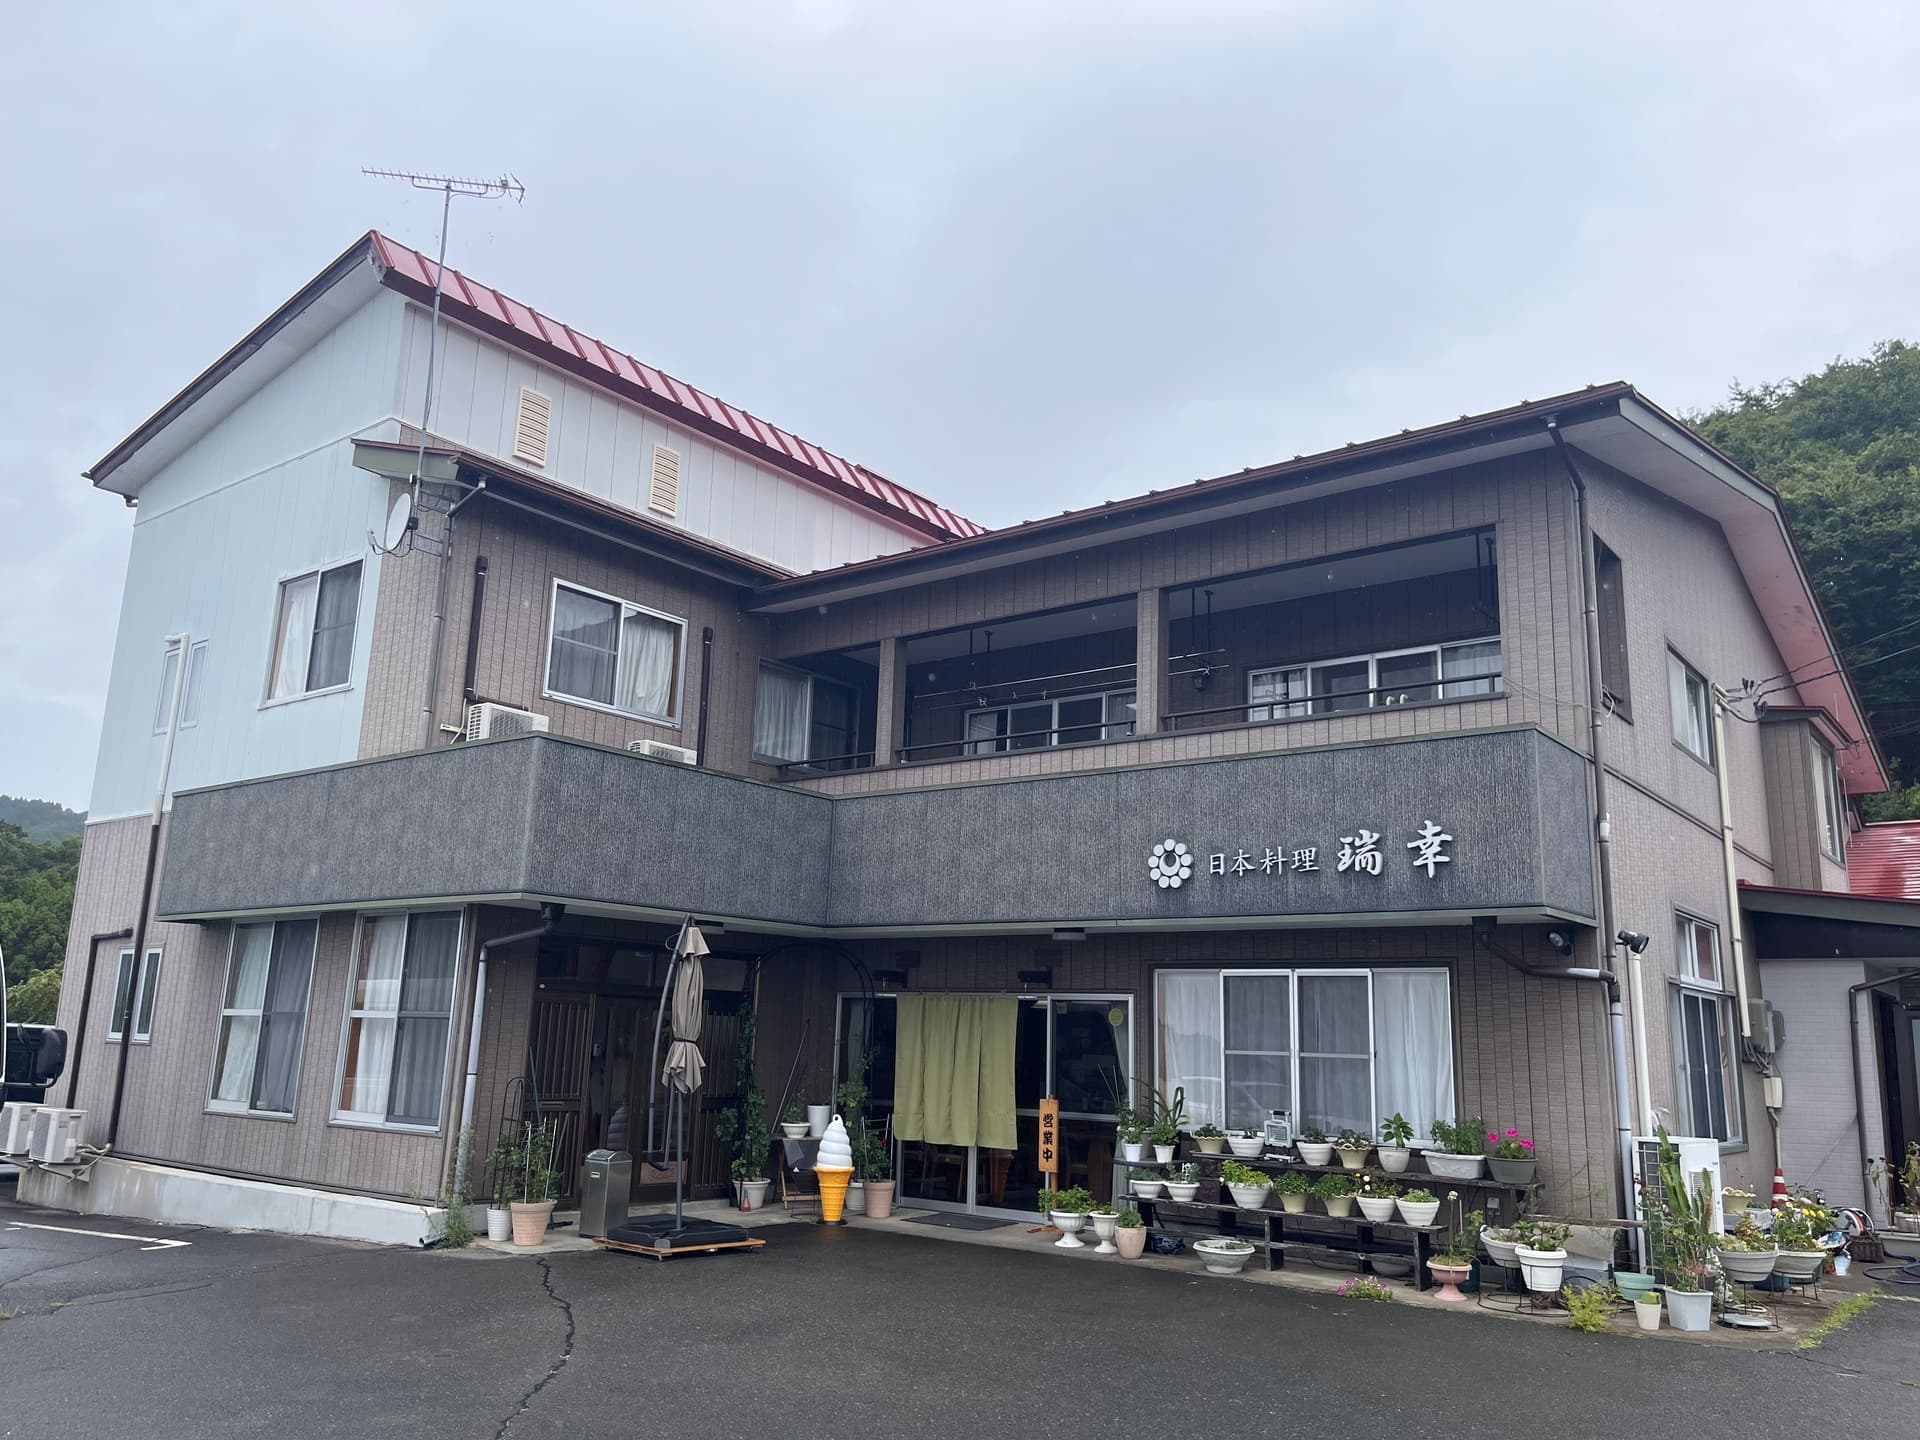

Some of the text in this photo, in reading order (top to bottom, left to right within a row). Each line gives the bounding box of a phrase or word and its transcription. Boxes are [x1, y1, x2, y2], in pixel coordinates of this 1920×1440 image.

[1208, 845, 1321, 877] 日本料理
[1042, 1113, 1054, 1163] 営業中
